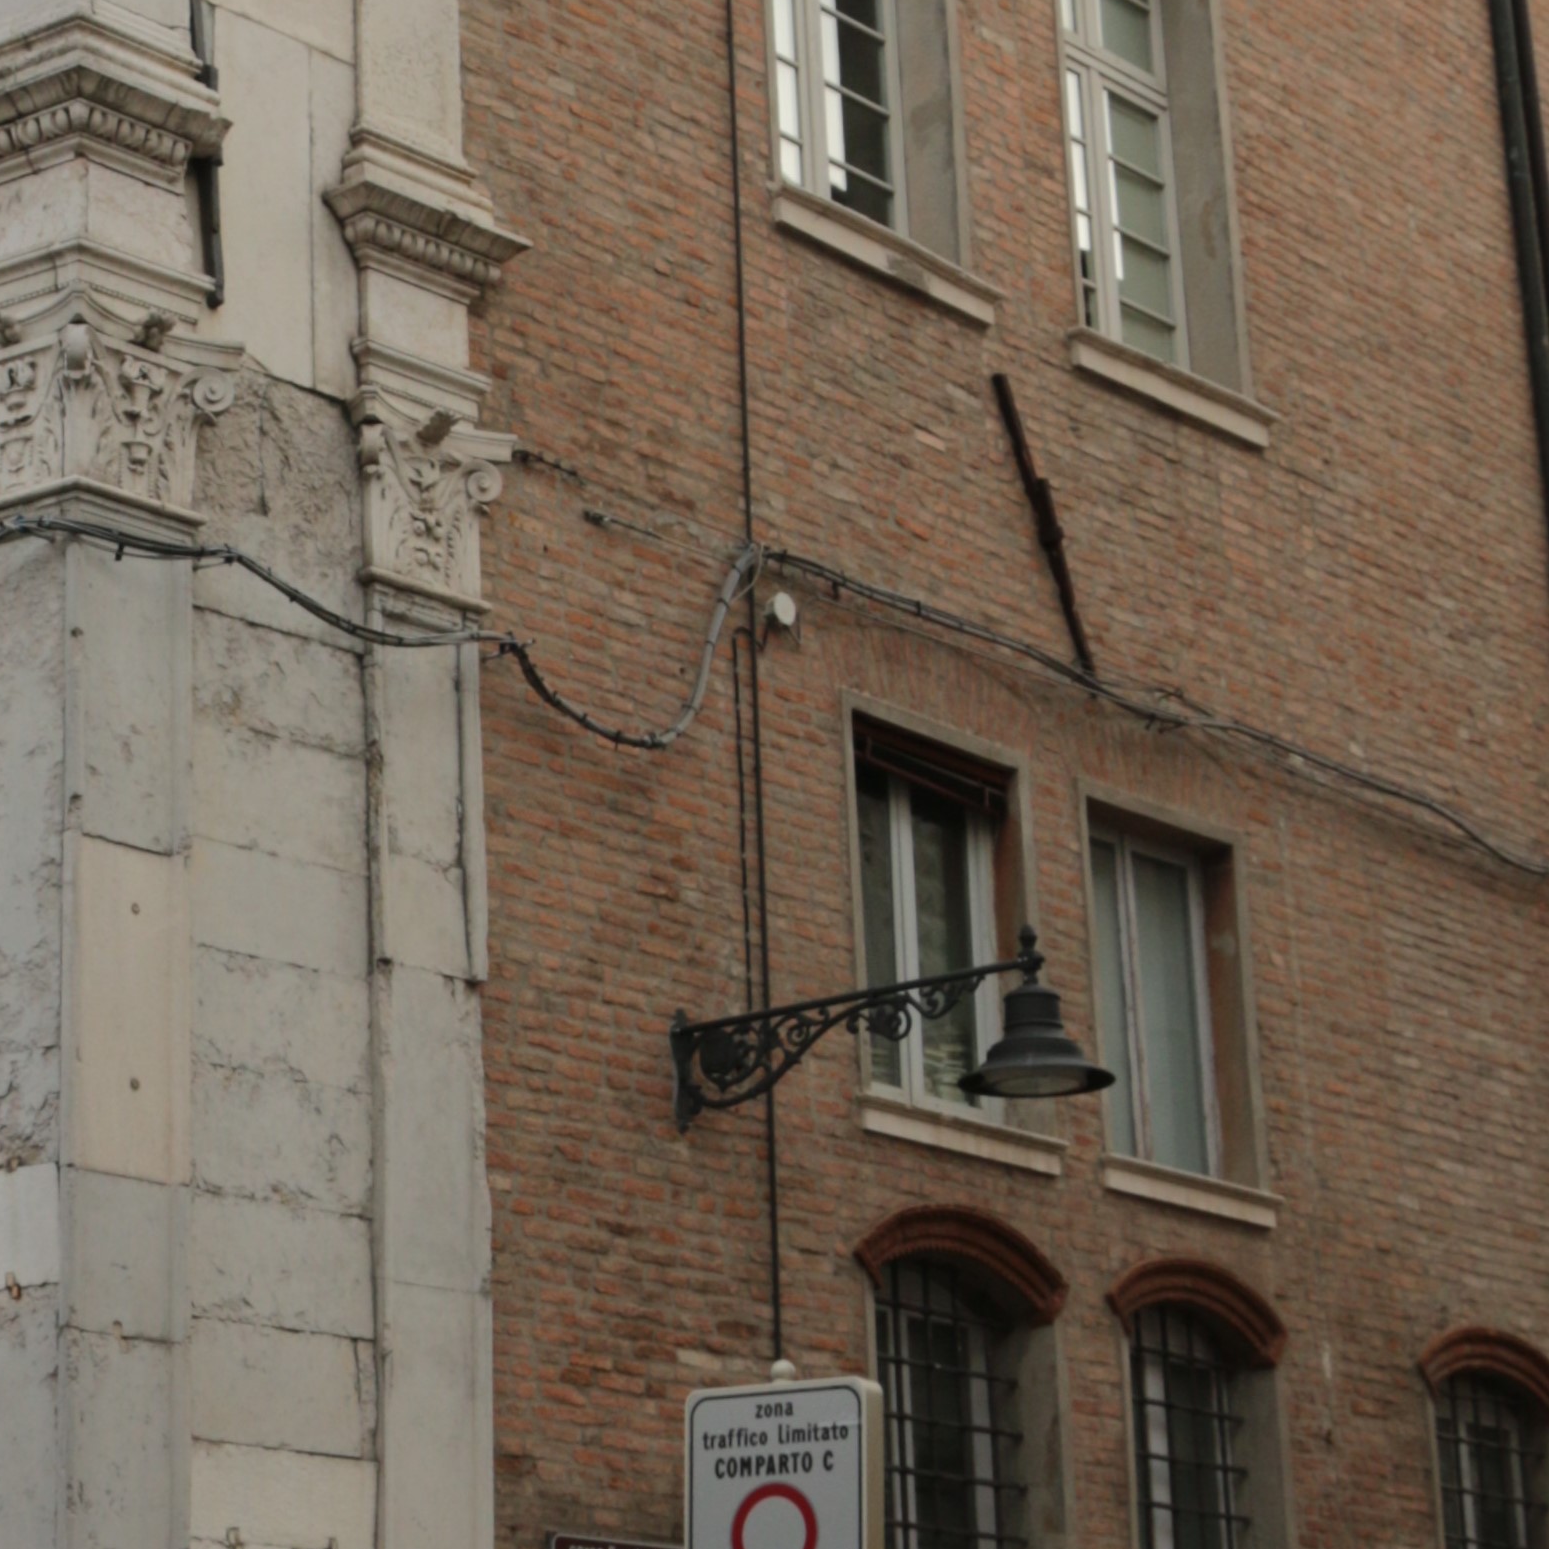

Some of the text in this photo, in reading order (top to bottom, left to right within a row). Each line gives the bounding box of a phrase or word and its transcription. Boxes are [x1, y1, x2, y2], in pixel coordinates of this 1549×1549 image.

[755, 1401, 794, 1419] zona
[703, 1422, 849, 1450] traffico limitato
[715, 1450, 834, 1479] COMPARTO C
